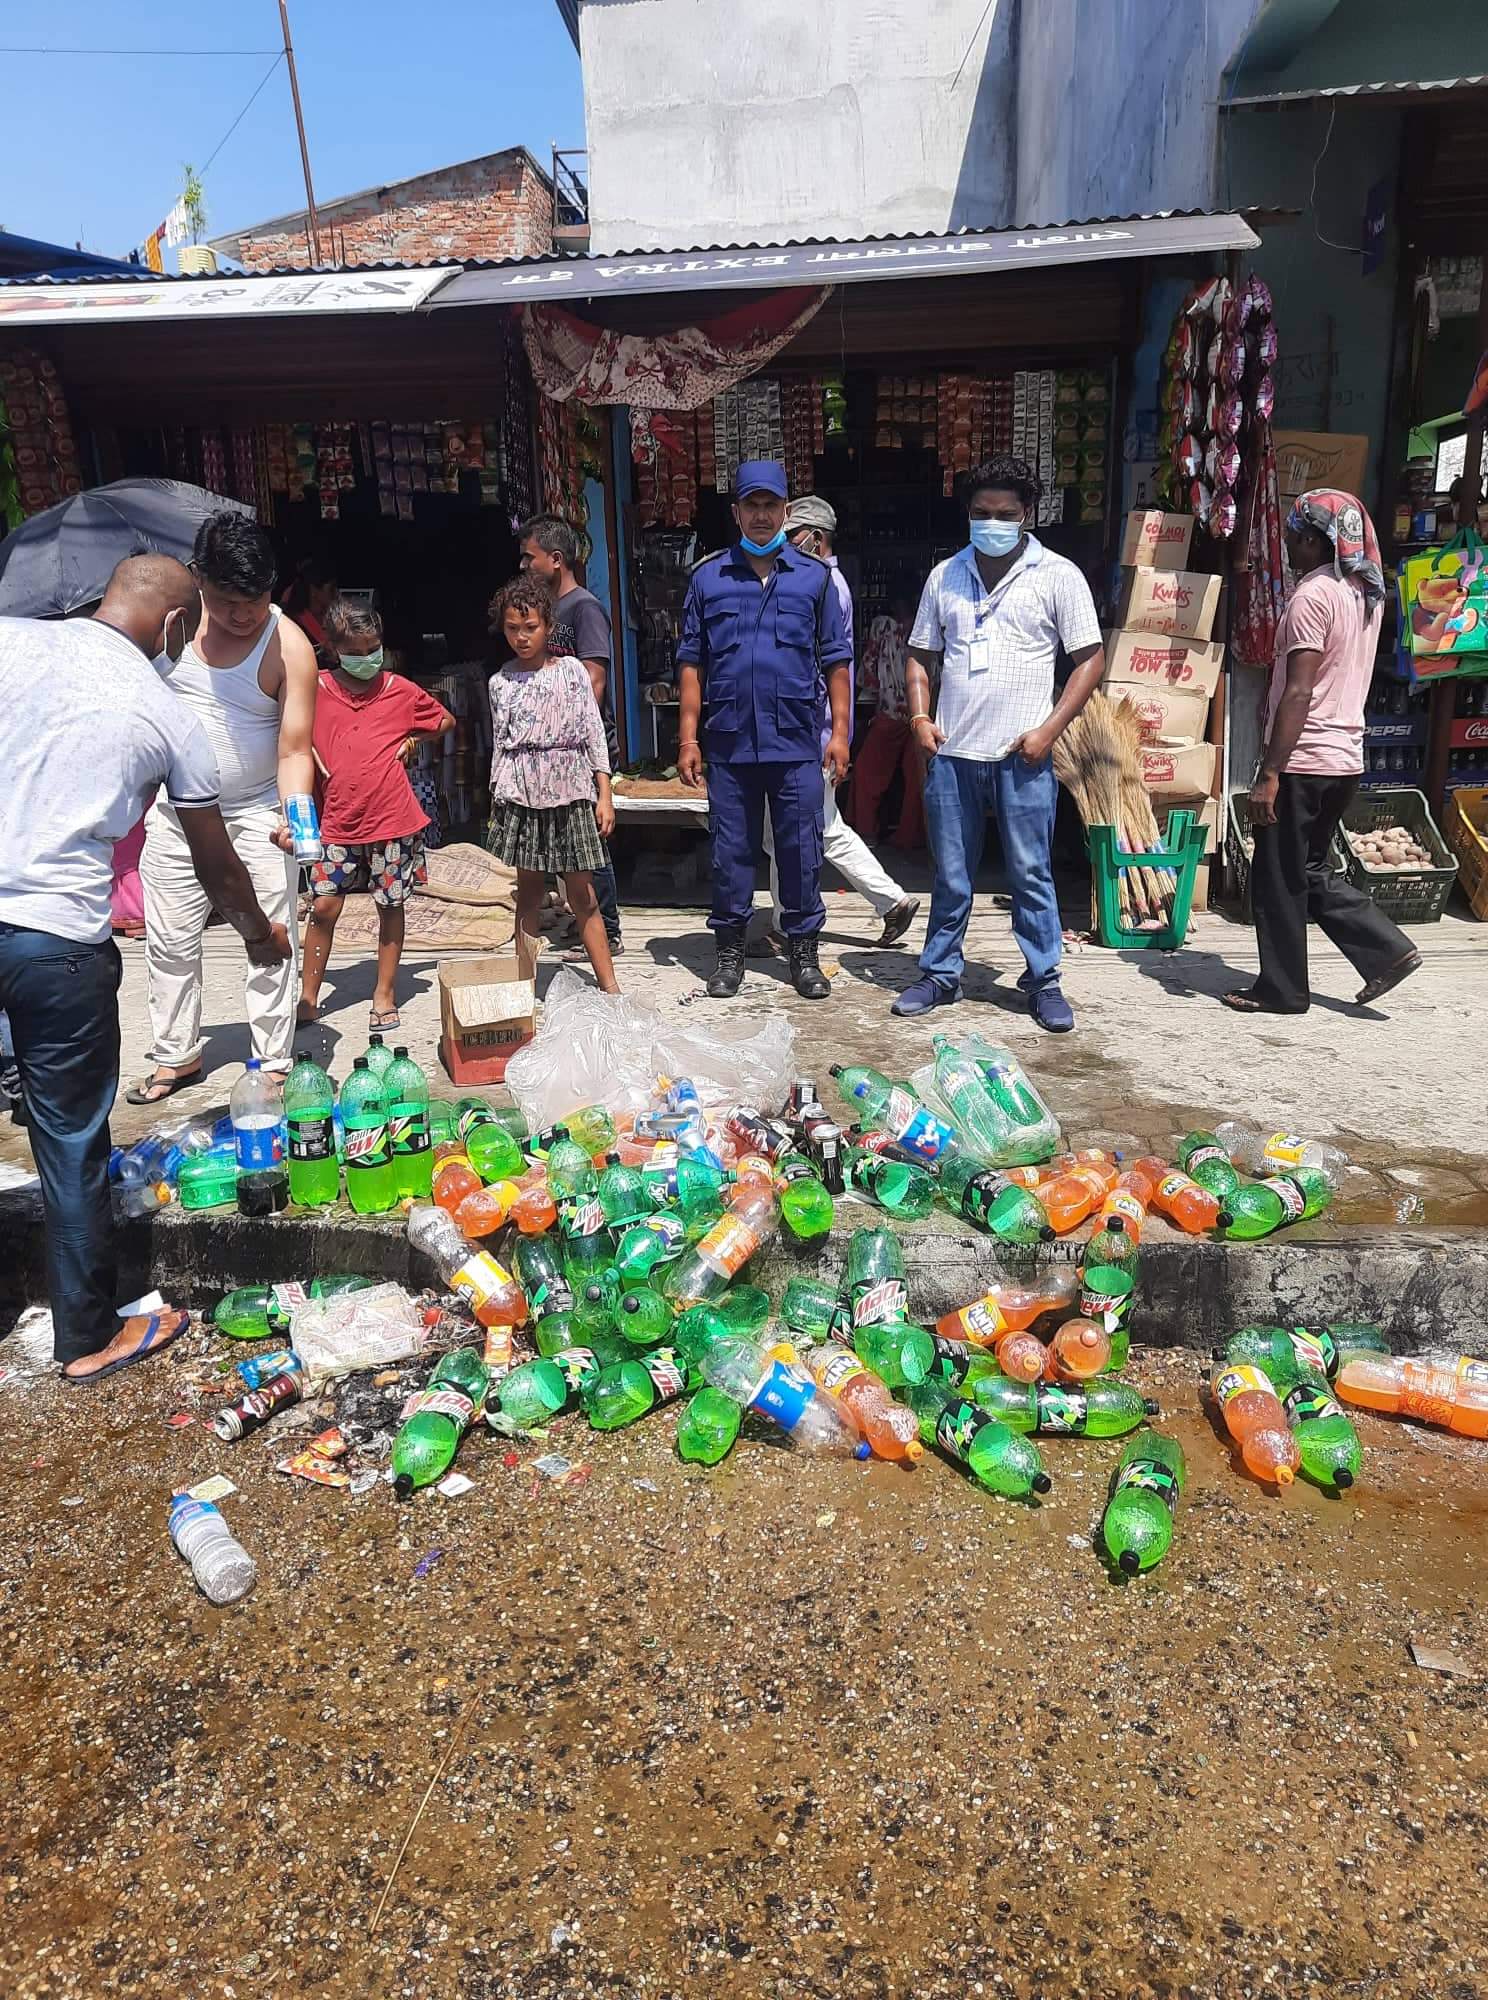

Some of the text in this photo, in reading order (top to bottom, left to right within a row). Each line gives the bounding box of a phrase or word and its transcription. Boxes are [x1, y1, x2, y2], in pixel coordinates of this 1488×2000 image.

[595, 255, 792, 279] EXTRA
[1129, 655, 1193, 682] GOL MOL
[1364, 724, 1413, 737] PEPSI
[967, 1302, 997, 1337] FANTA
[824, 1355, 864, 1389] FANTA
